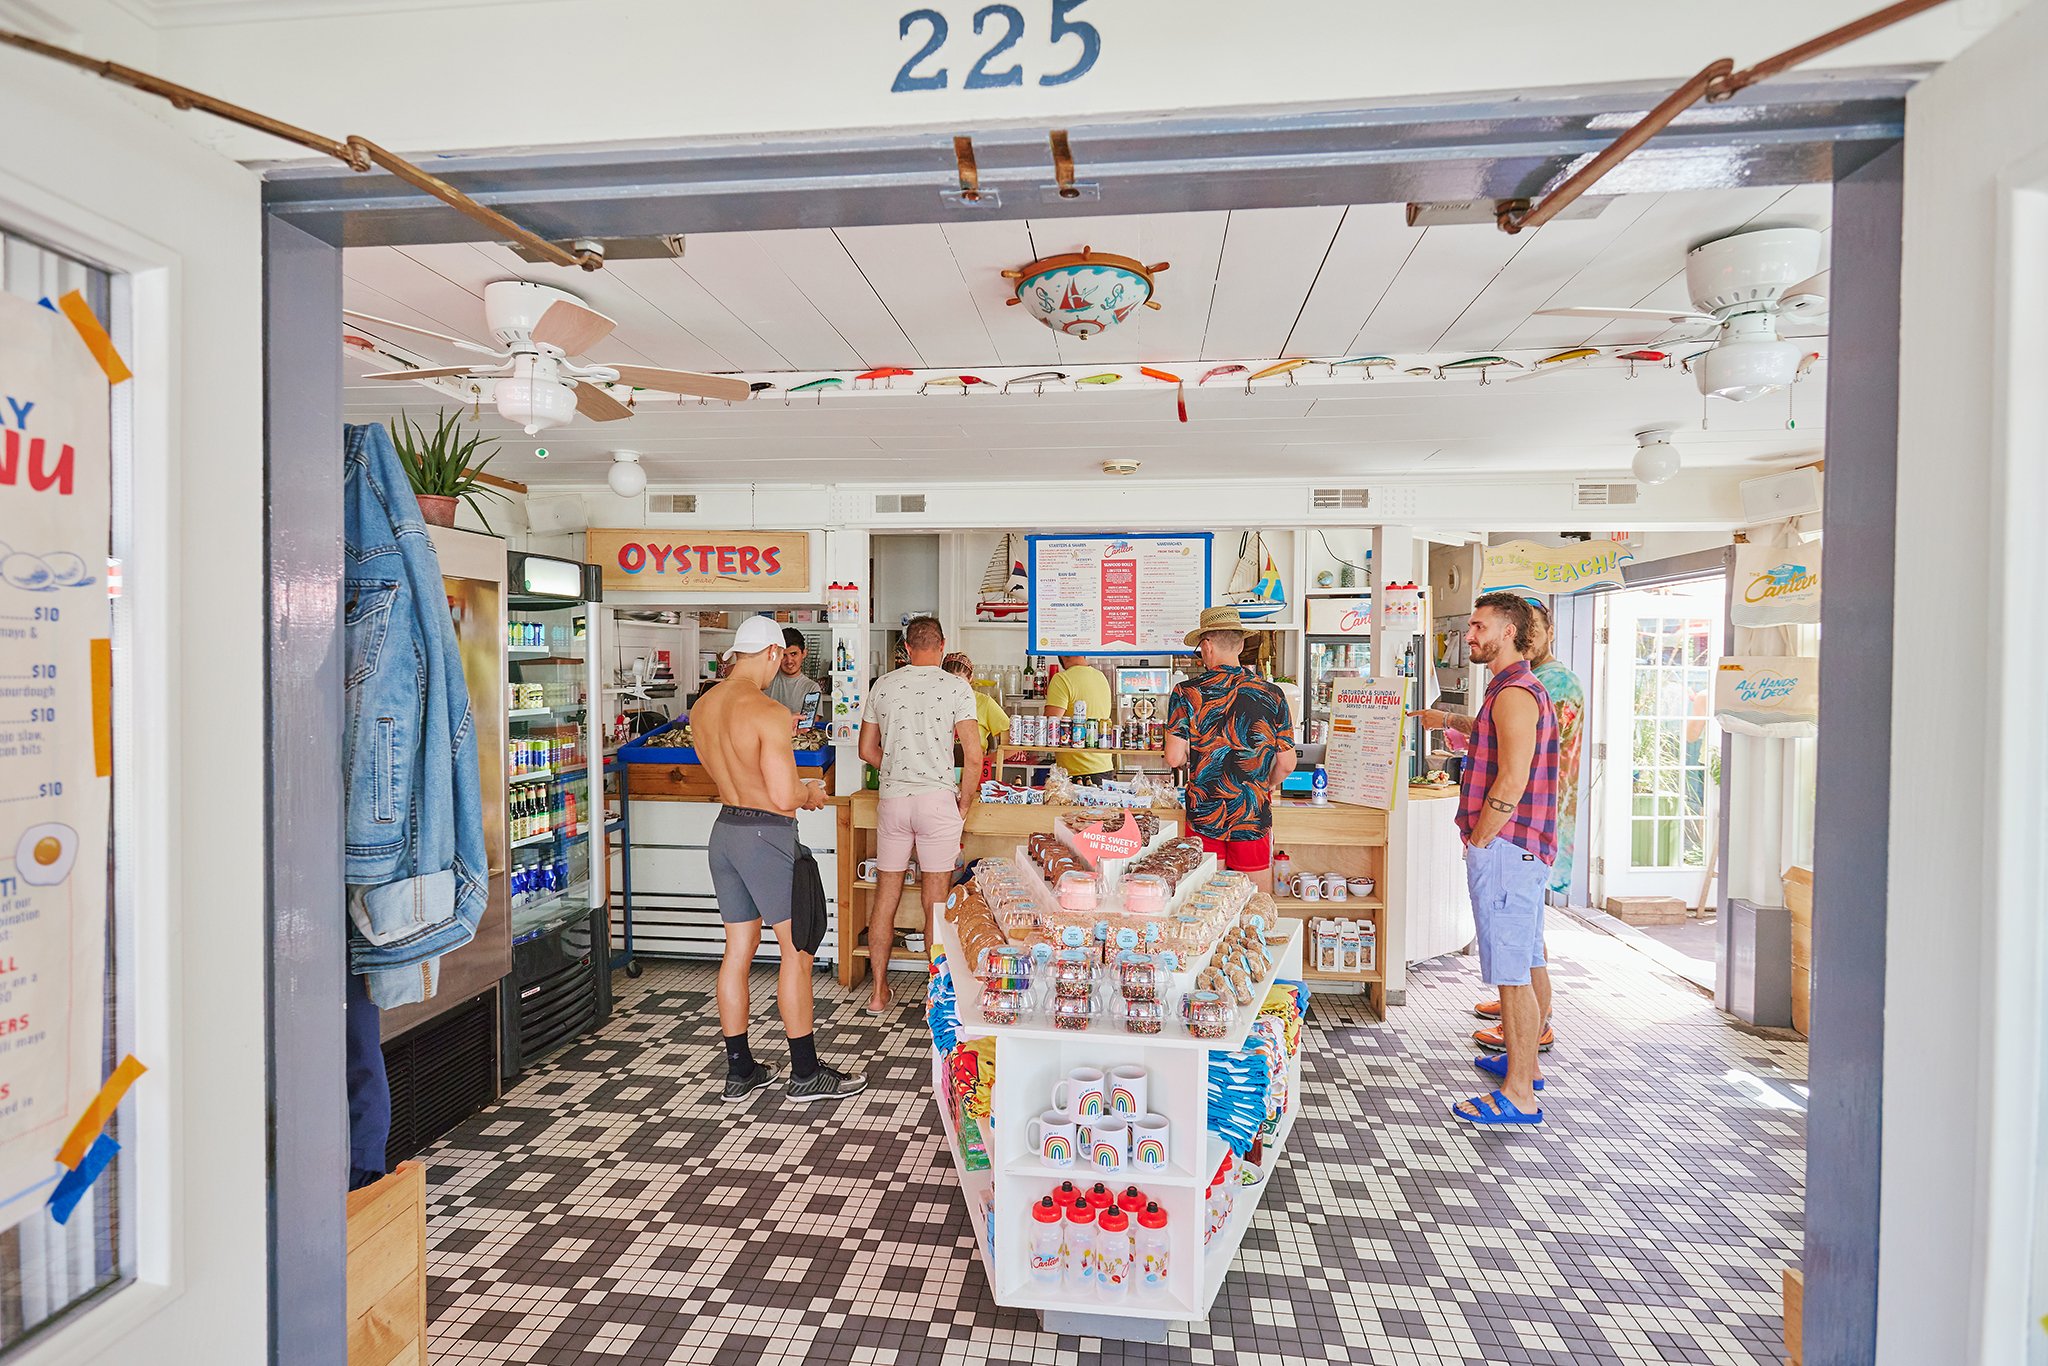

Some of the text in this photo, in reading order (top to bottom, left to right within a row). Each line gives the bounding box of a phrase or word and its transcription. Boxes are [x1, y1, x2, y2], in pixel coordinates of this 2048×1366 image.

[891, 0, 1101, 92] 225
[618, 543, 782, 576] OYSTERS
[1533, 552, 1617, 583] BEACH!
[1744, 572, 1817, 603] Canteen
[1735, 677, 1799, 691] ALL HANDS
[1337, 694, 1401, 705] BRUNCH MENU
[1740, 688, 1793, 701] ON DECK
[1082, 832, 1139, 848] MORE SWEETS
[1089, 841, 1129, 854] IN FRIDGE
[1032, 1256, 1060, 1269] Canteen
